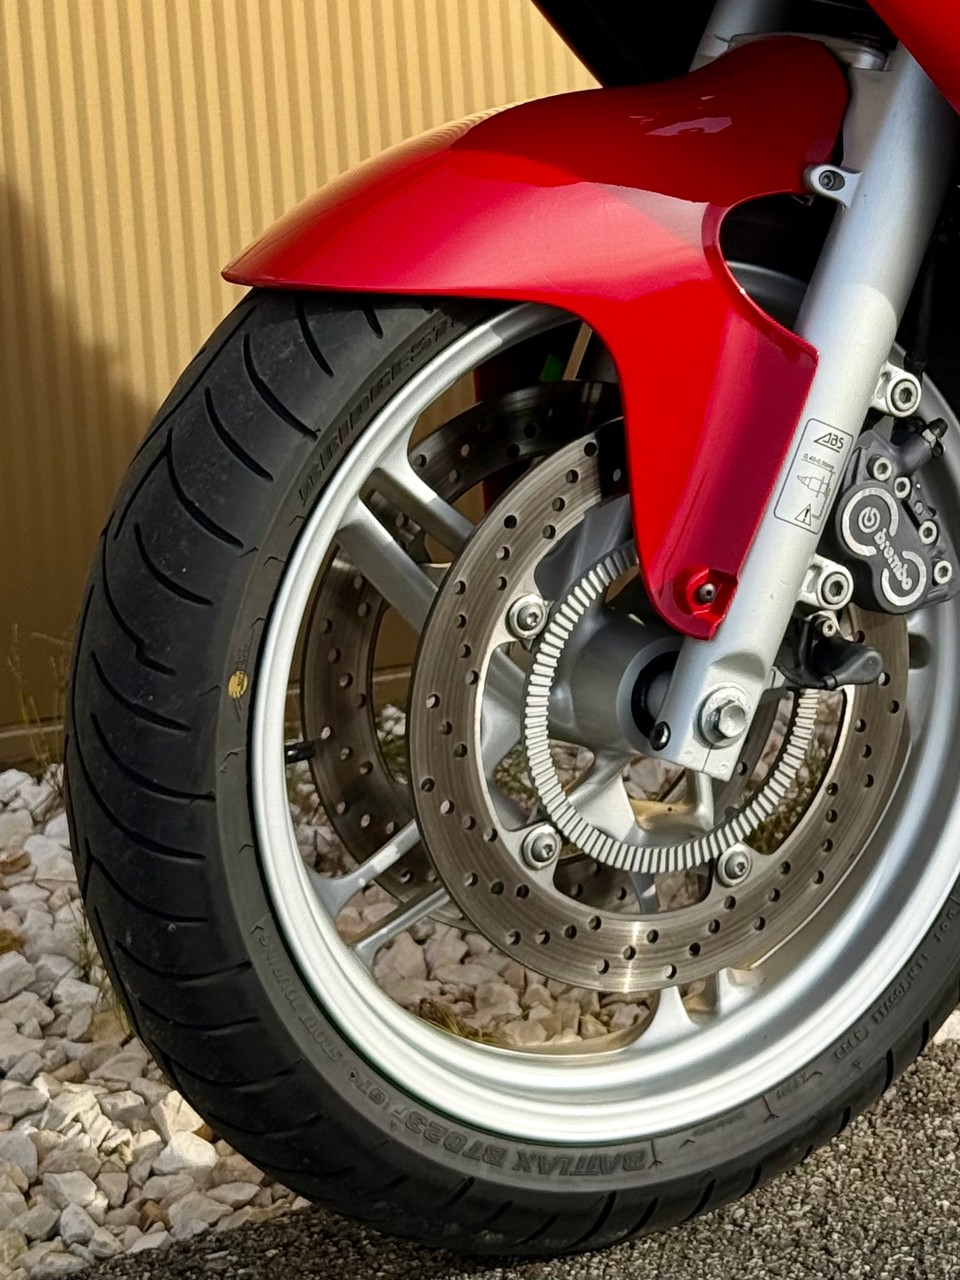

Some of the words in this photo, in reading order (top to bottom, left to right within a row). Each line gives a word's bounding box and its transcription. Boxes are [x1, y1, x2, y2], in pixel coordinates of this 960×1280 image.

[814, 432, 844, 452] ABS
[873, 527, 912, 591] brembo
[510, 1148, 646, 1177] BATTLAX
